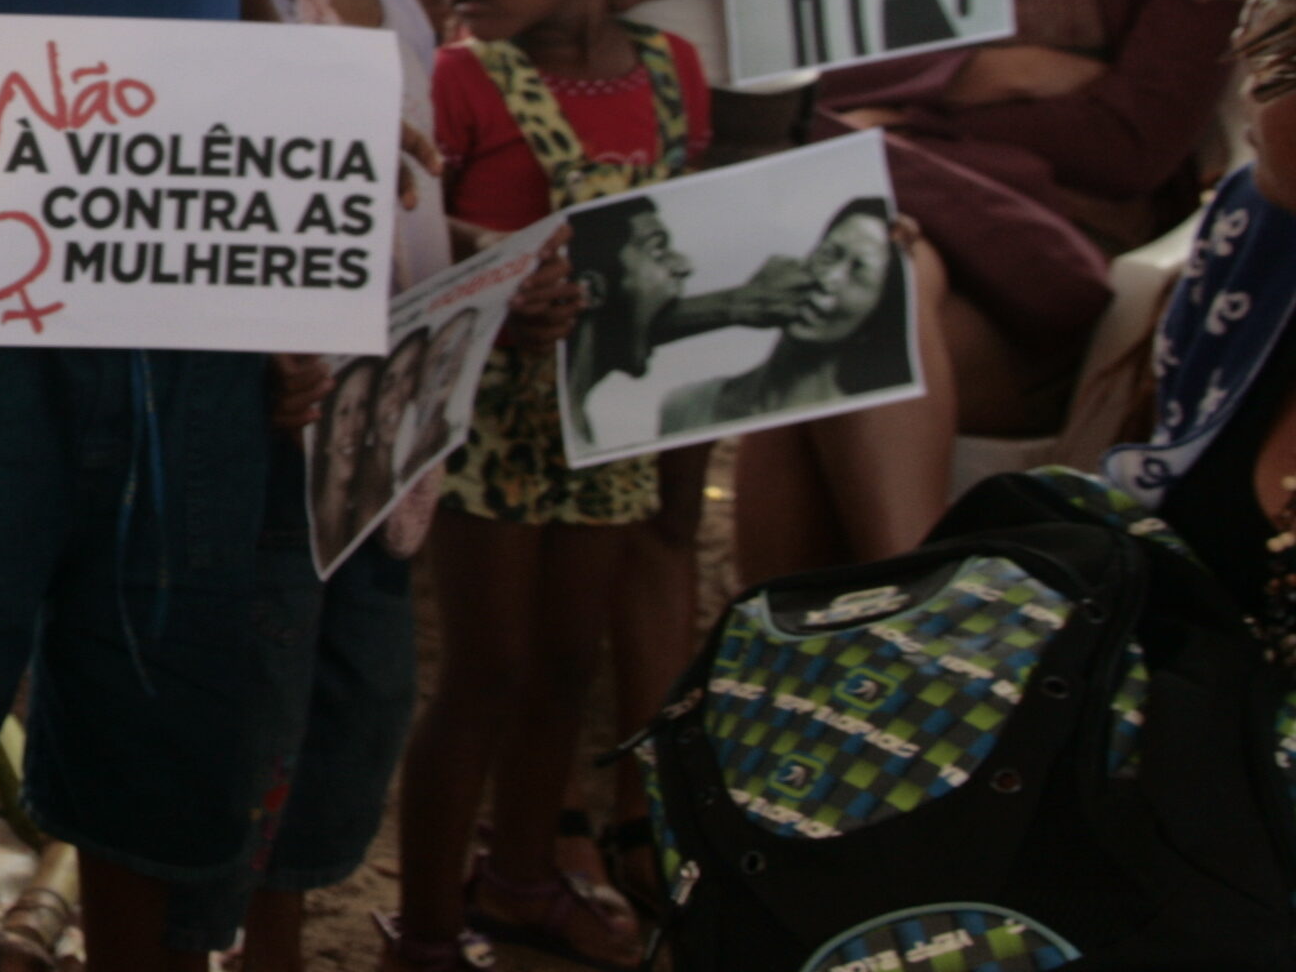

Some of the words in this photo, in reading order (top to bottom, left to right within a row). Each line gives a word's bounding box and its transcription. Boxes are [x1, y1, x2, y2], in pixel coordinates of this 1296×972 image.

[4, 117, 49, 174] À
[64, 123, 377, 183] VIOLÊNCIA
[41, 186, 279, 233] CONTRA
[295, 192, 375, 237] AS
[63, 241, 370, 291] MULHERES
